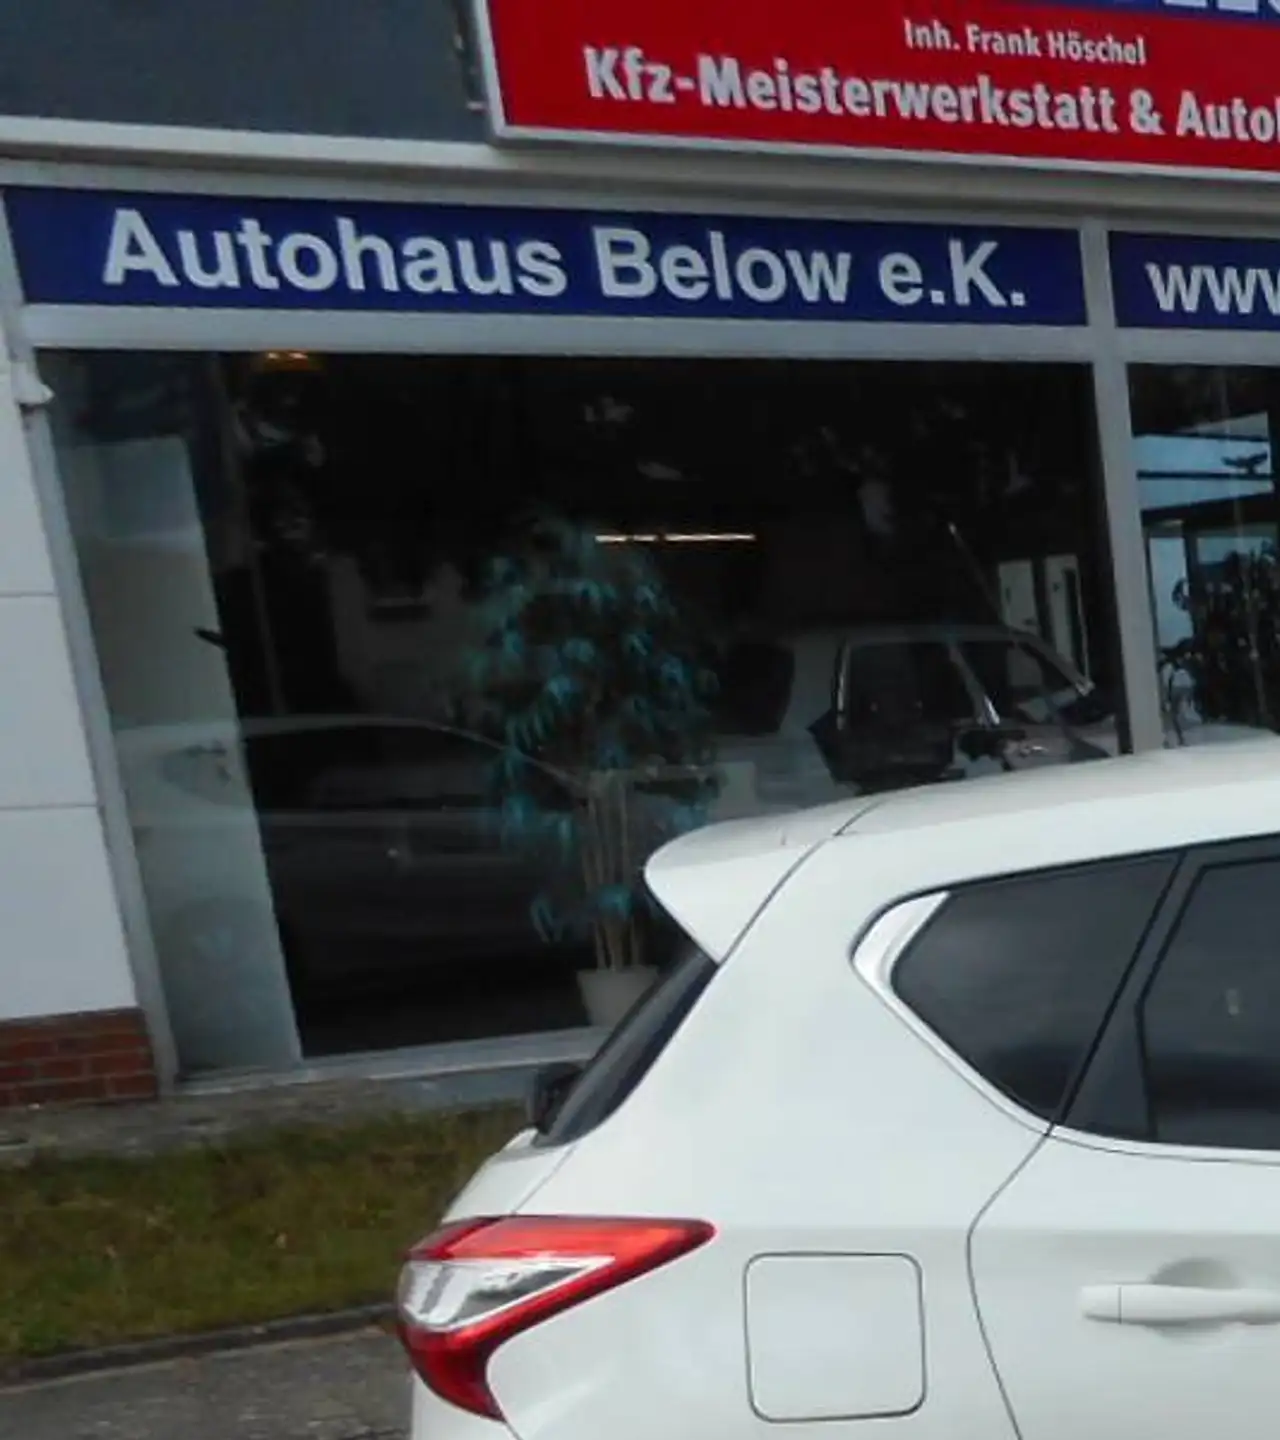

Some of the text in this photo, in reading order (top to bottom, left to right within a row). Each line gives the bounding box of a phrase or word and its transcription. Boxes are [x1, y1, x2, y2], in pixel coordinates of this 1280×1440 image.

[903, 18, 1147, 66] Inh. Frank Höschel
[583, 45, 1119, 134] Kfz-Meisterwerkstatt
[1129, 88, 1166, 135] &
[103, 208, 1027, 307] Autohaus Below e.K.
